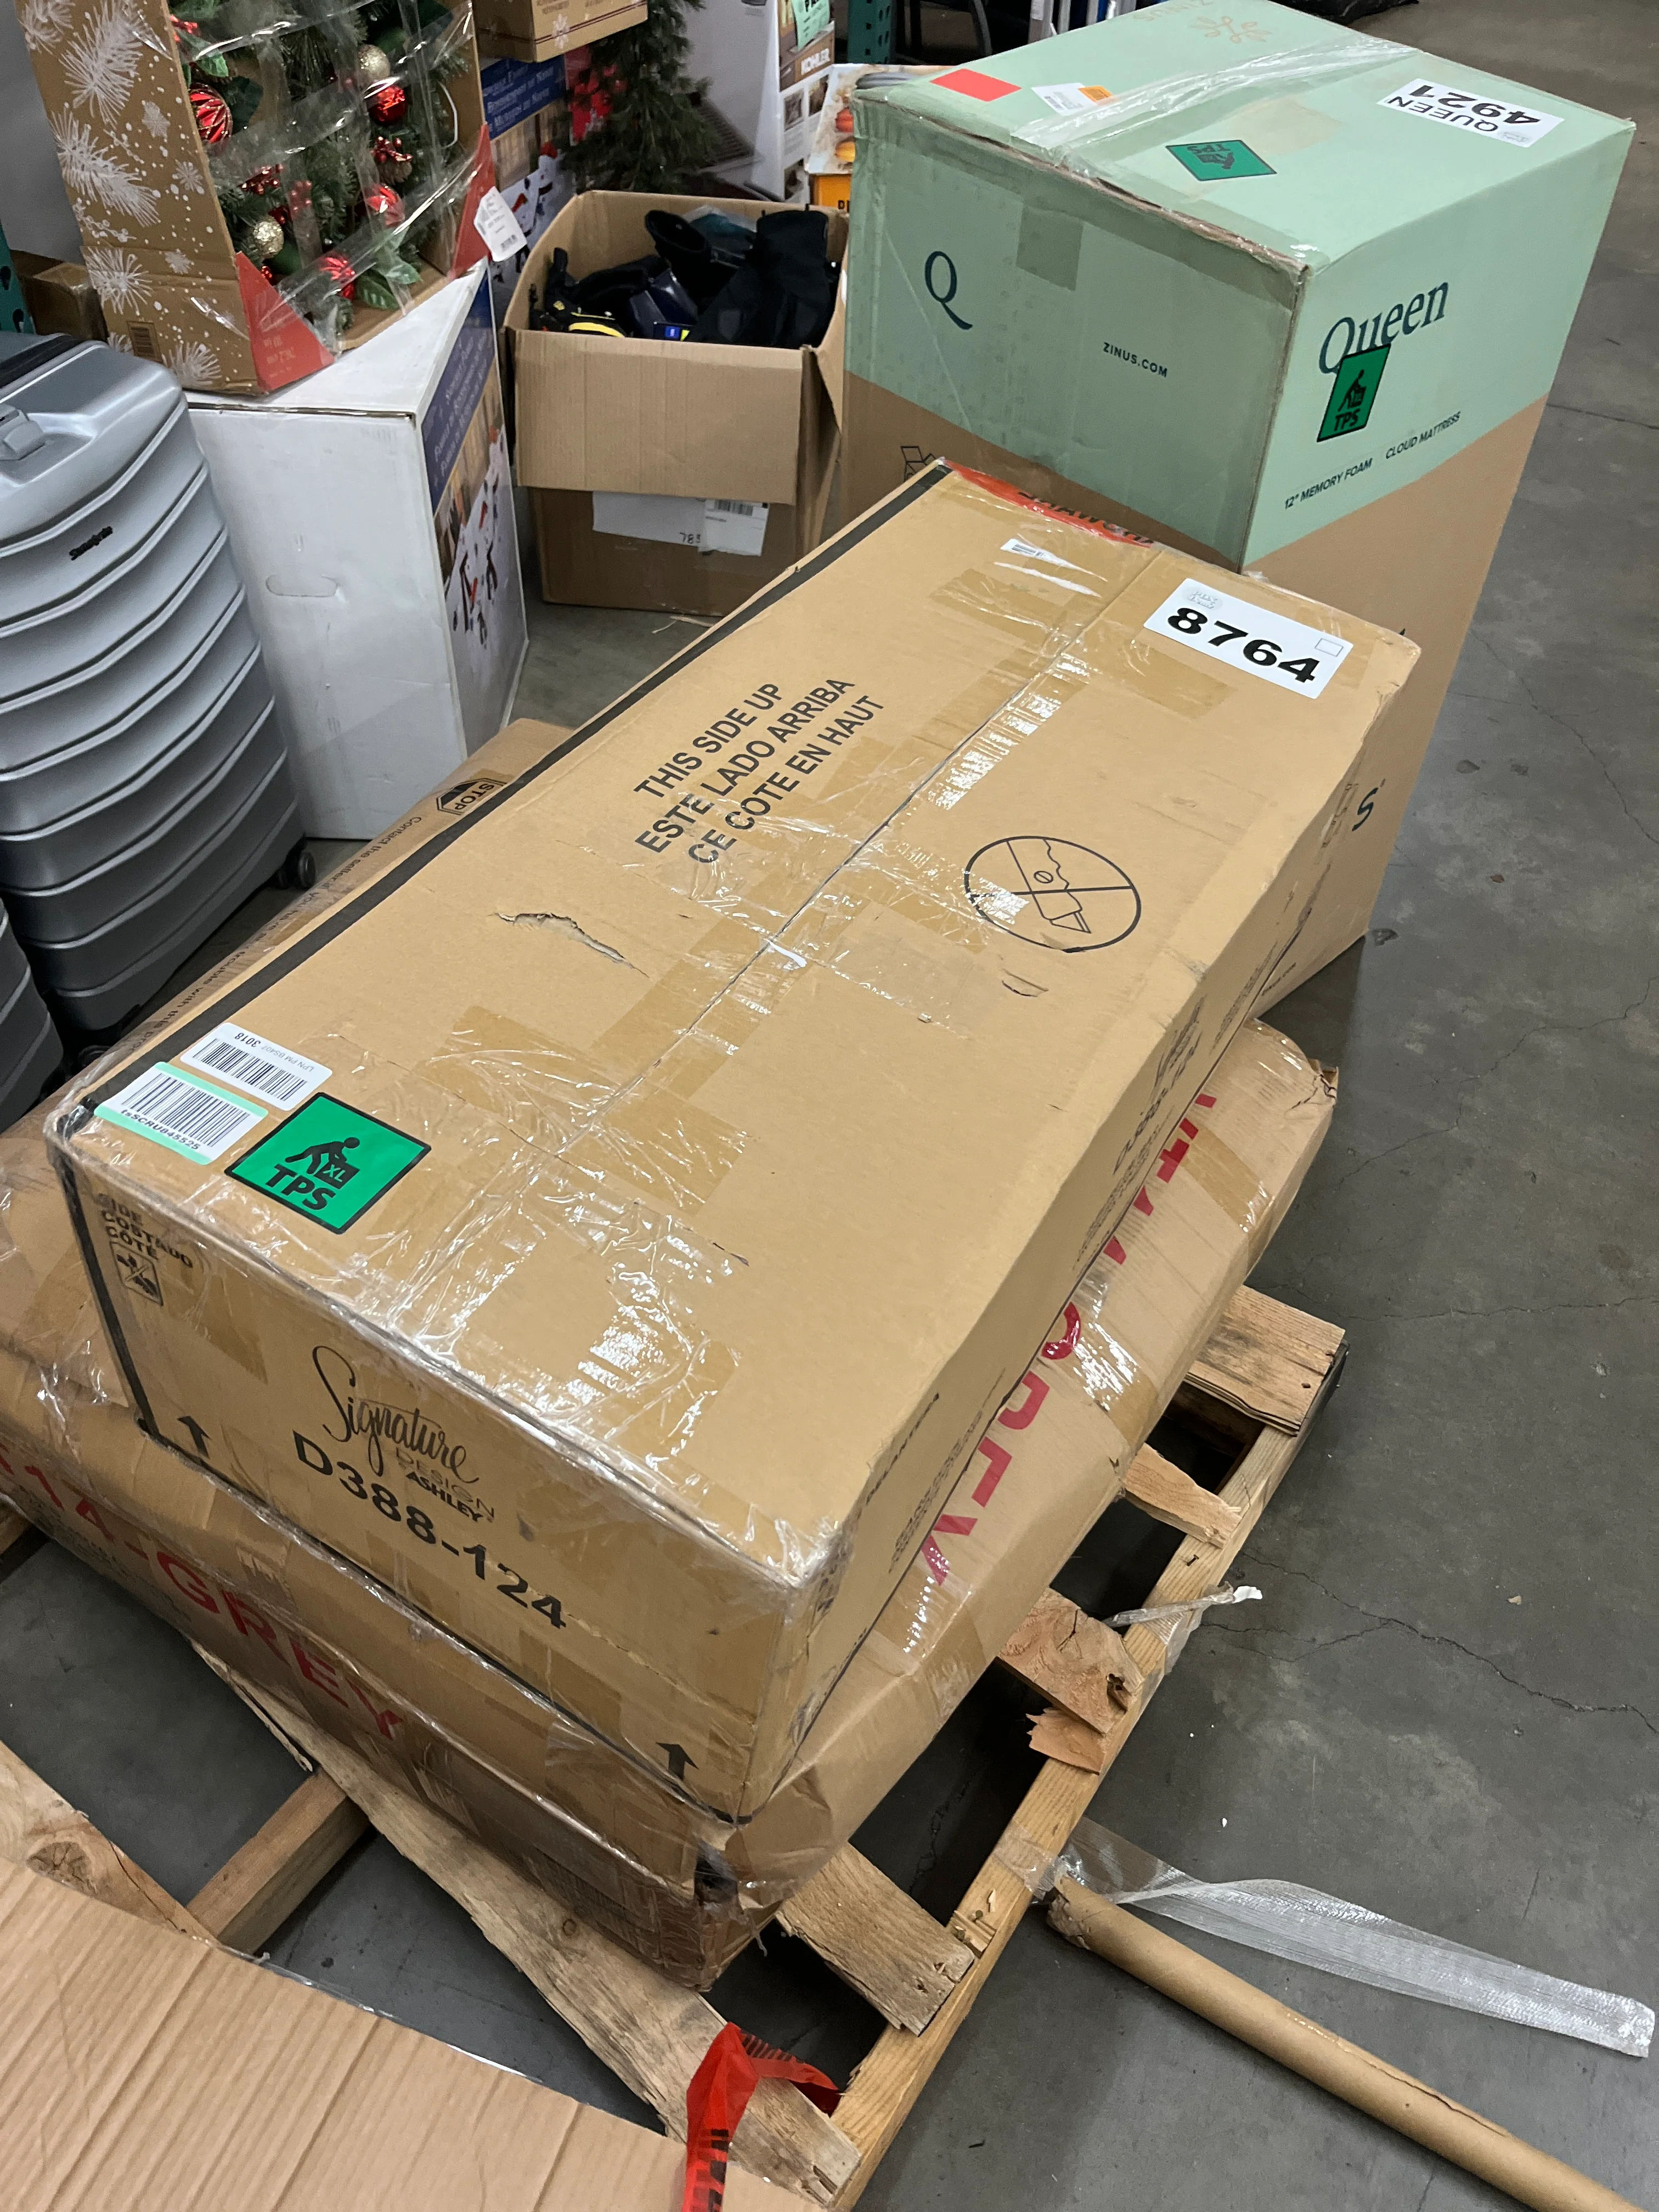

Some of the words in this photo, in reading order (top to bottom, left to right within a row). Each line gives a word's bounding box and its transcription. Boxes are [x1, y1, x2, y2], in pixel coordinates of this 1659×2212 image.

[1387, 95, 1499, 132] QUEEN
[1409, 84, 1541, 125] 4921
[1187, 143, 1231, 154] TPS
[924, 250, 973, 330] Q
[1318, 281, 1449, 374] Queen
[1103, 341, 1168, 378] ZINUS.COM
[1333, 408, 1361, 432] TPS
[1300, 471, 1344, 502] MEMORY
[1344, 458, 1373, 481] FOAM
[1385, 436, 1418, 459] CLOUD
[1418, 411, 1462, 444] MATTRESS
[1166, 607, 1321, 684] 8764
[633, 752, 703, 798] THIS
[692, 708, 758, 753] SIDE
[744, 683, 783, 711] UP
[634, 793, 715, 853] ESTE
[700, 740, 775, 797] LADO
[766, 679, 856, 744] ARRIBA
[687, 828, 737, 864] CE
[725, 771, 800, 831] COTE
[785, 743, 832, 775] EN
[816, 695, 884, 746] HAUT
[454, 783, 495, 810] STOP
[379, 816, 422, 845] Contact
[331, 859, 361, 882] seller
[360, 845, 382, 859] the
[202, 951, 246, 985] trouble
[177, 987, 205, 1008] with
[154, 1010, 178, 1029] this
[234, 1031, 262, 1048] 3018
[261, 1044, 287, 1059] BS407
[283, 1053, 297, 1064] PM
[297, 1059, 315, 1073] LPN
[265, 1163, 336, 1211] TPS
[323, 1164, 346, 1183] XL
[312, 1345, 480, 1484] Signature
[405, 1471, 484, 1522] ASHLEY
[292, 1430, 567, 1629] D388-124
[0, 1442, 404, 1740] 14-GREY
